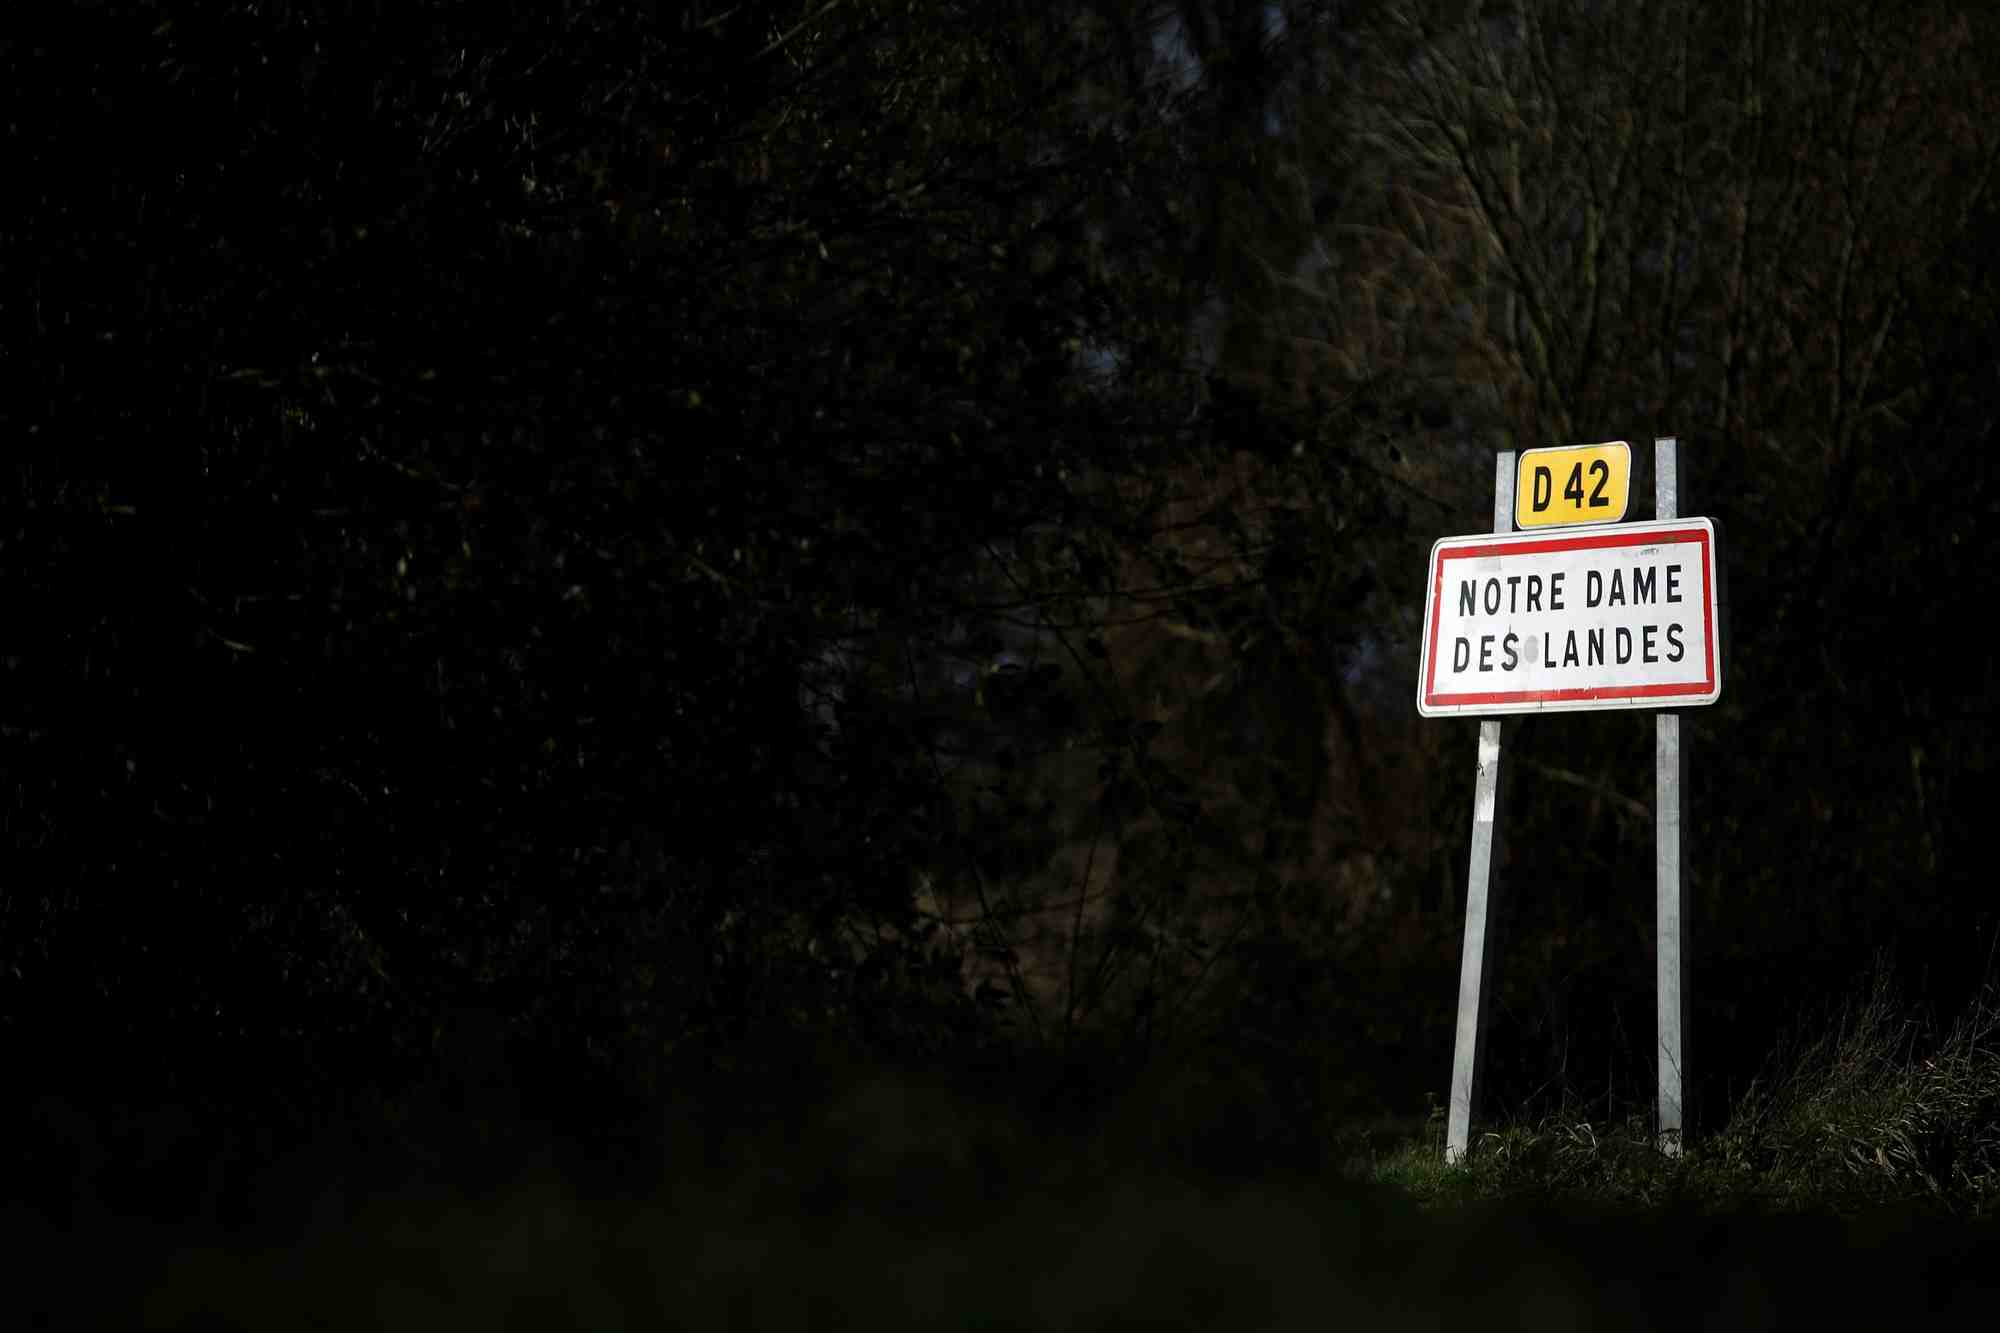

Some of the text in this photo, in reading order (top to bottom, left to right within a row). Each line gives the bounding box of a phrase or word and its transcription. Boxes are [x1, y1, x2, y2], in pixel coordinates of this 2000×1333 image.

[1533, 460, 1609, 513] D 42
[1459, 565, 1682, 617] NOTRE DAME
[1453, 624, 1685, 673] DES LANDES
